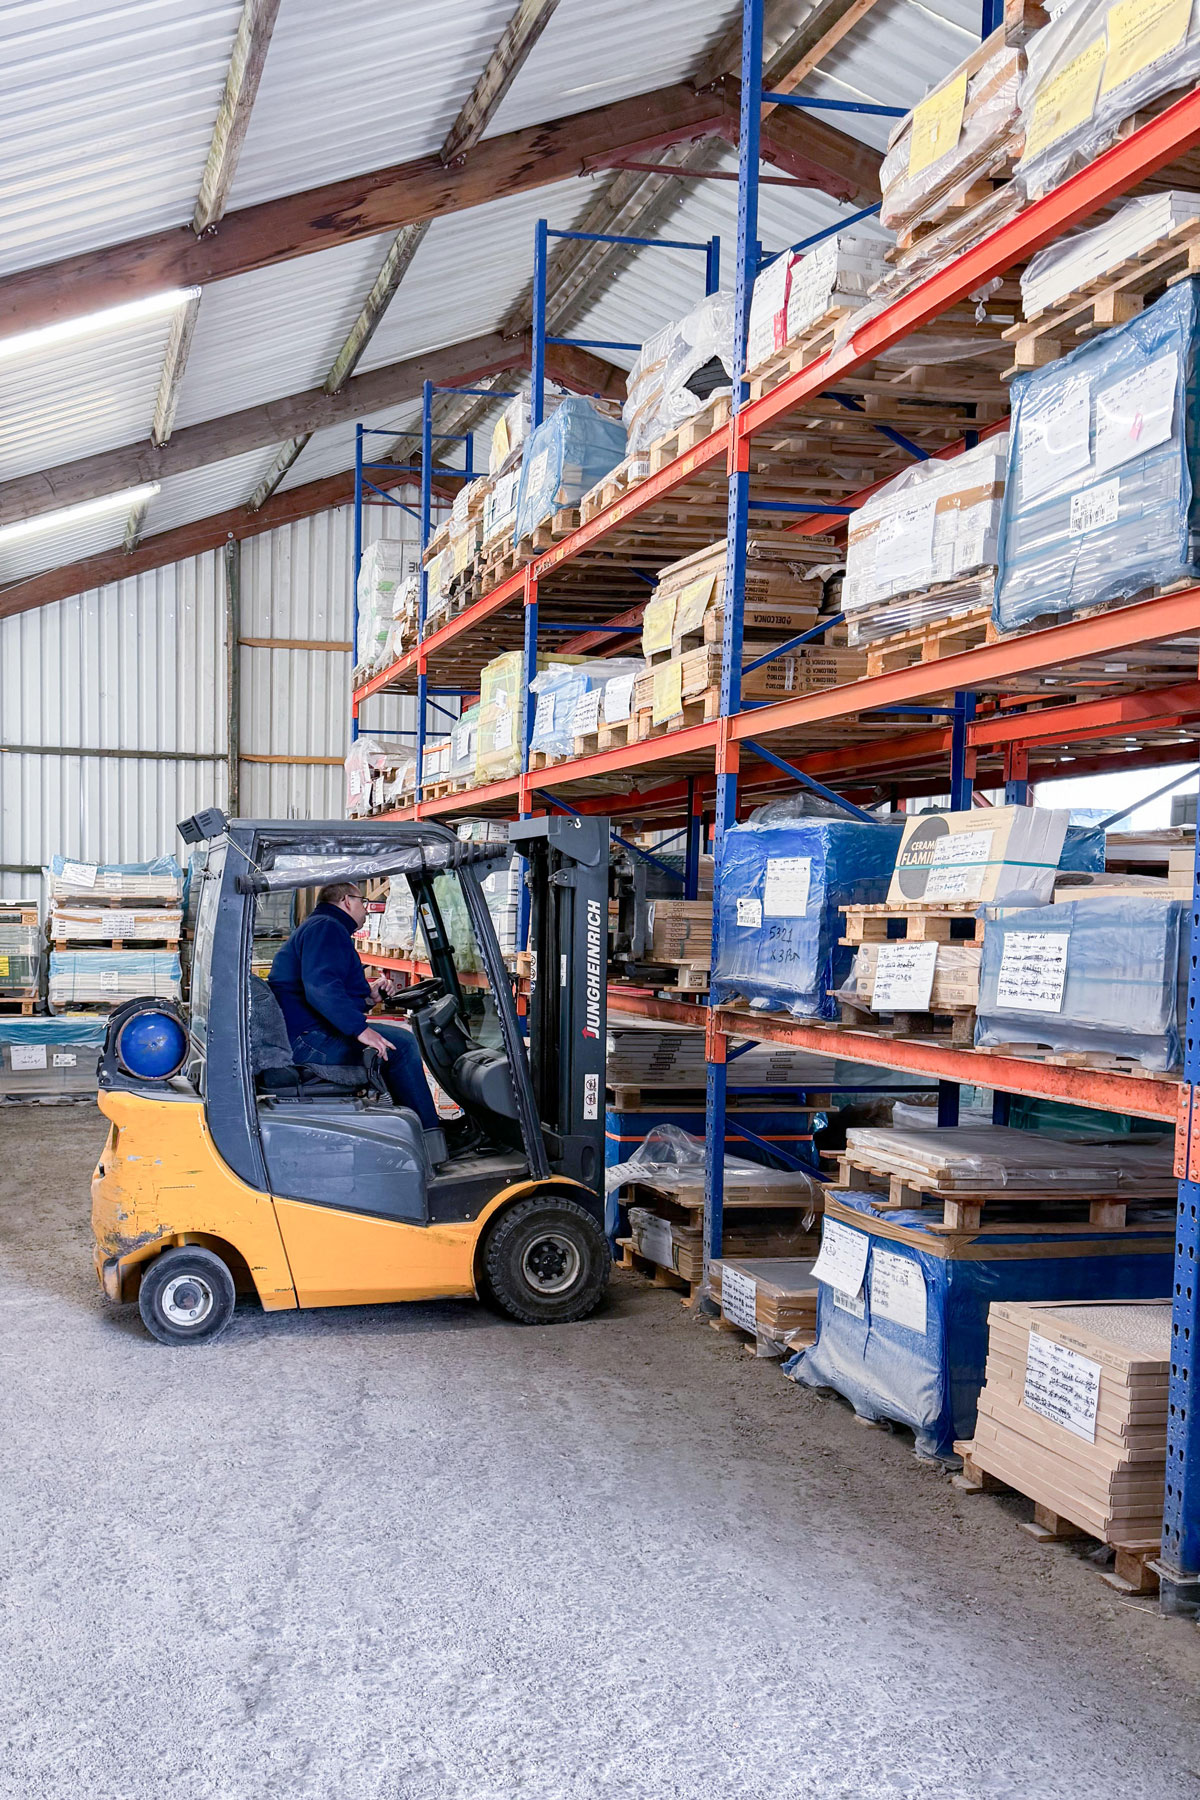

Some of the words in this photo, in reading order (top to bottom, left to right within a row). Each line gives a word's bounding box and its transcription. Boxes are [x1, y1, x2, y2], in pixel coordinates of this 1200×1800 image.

[911, 840, 936, 851] CERAM
[769, 925, 793, 943] 5321
[581, 899, 601, 1040] JUNGHEINRICH
